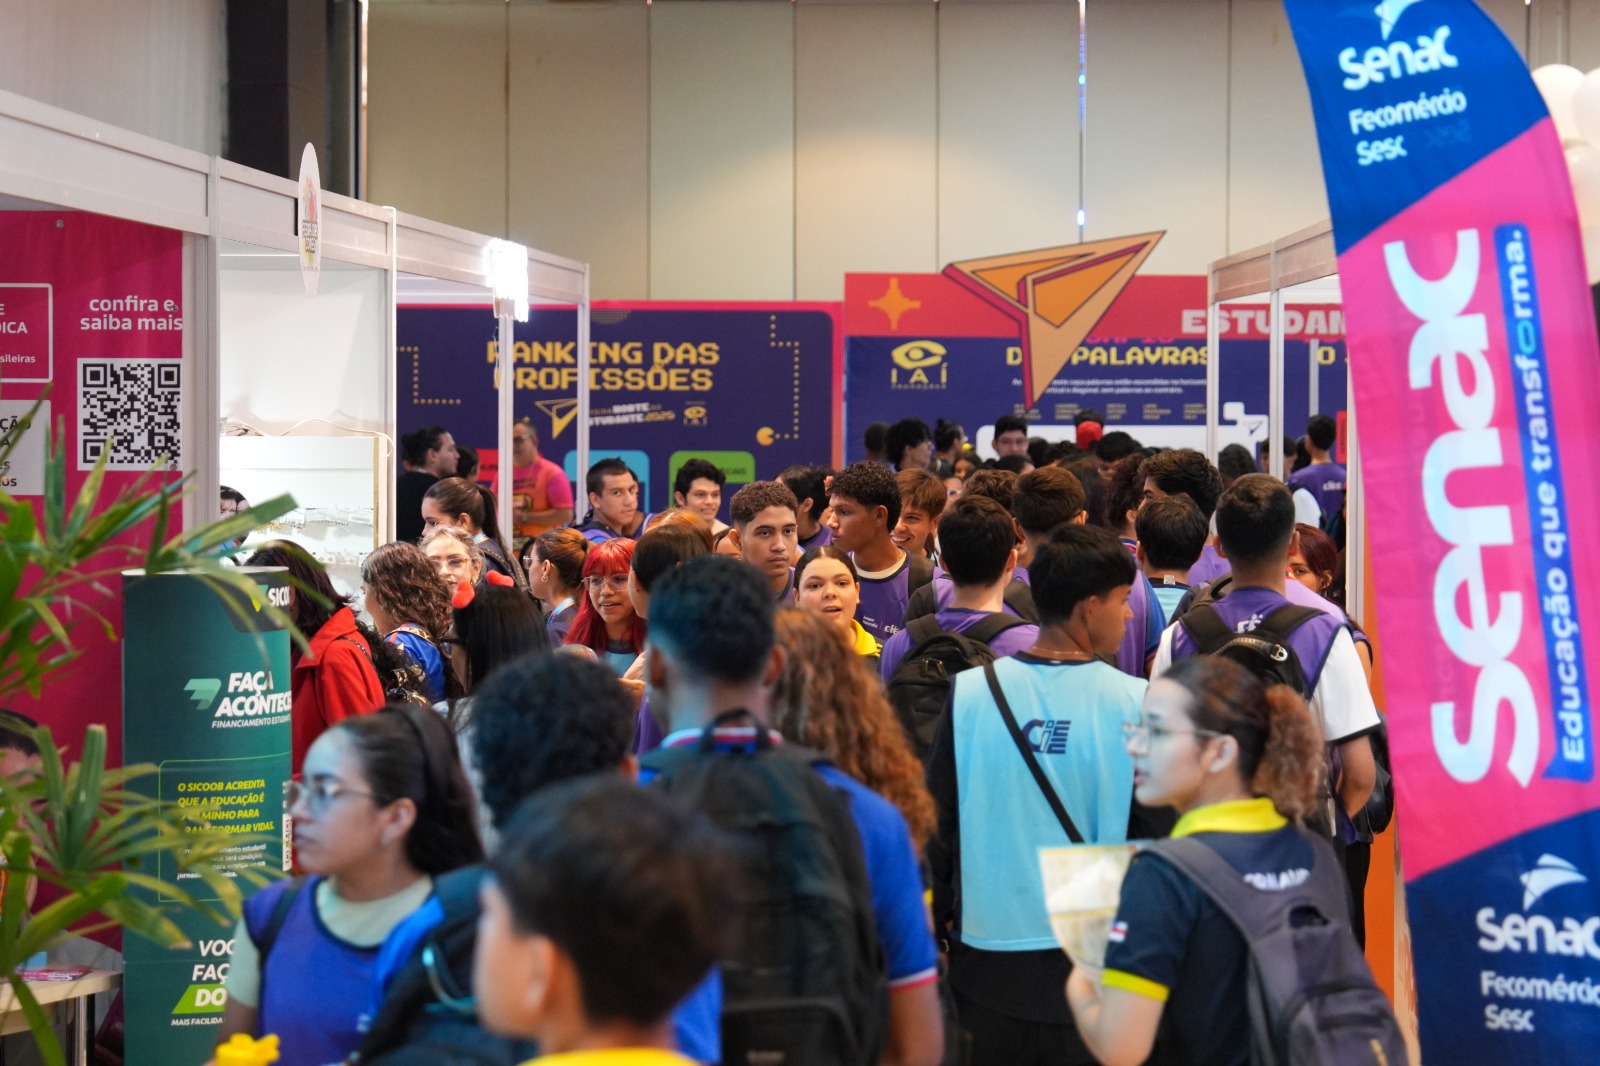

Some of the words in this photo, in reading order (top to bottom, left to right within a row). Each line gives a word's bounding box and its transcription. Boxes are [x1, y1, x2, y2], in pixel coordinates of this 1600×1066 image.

[1338, 24, 1459, 90] Senac
[1349, 87, 1467, 136] Fecomércio
[1356, 135, 1408, 166] Sesc
[88, 295, 158, 312] confira
[163, 298, 175, 312] e
[80, 314, 132, 331] saiba
[137, 315, 183, 331] mais
[652, 341, 720, 364] DAS
[1506, 228, 1553, 475] transforma.
[1537, 478, 1566, 560] que
[1544, 567, 1586, 764] Educação
[227, 670, 274, 698] FAÇA
[211, 717, 271, 729] FINANCIAMENTO
[177, 783, 187, 792] O
[187, 782, 224, 792] SICOOB
[224, 779, 266, 791] ACREDITA
[177, 797, 200, 808] QUE
[200, 797, 208, 806] A
[210, 793, 259, 806] EDUCAÇÃO
[259, 792, 265, 802] É
[190, 811, 236, 820] MINHO
[237, 809, 260, 818] PARA
[253, 821, 275, 832] VIDAS.
[199, 939, 236, 957] VOC
[192, 962, 231, 985] FAÇ
[171, 1018, 190, 1026] MAIS
[190, 1016, 224, 1026] FACILIDA
[1485, 1004, 1535, 1032] Sesc
